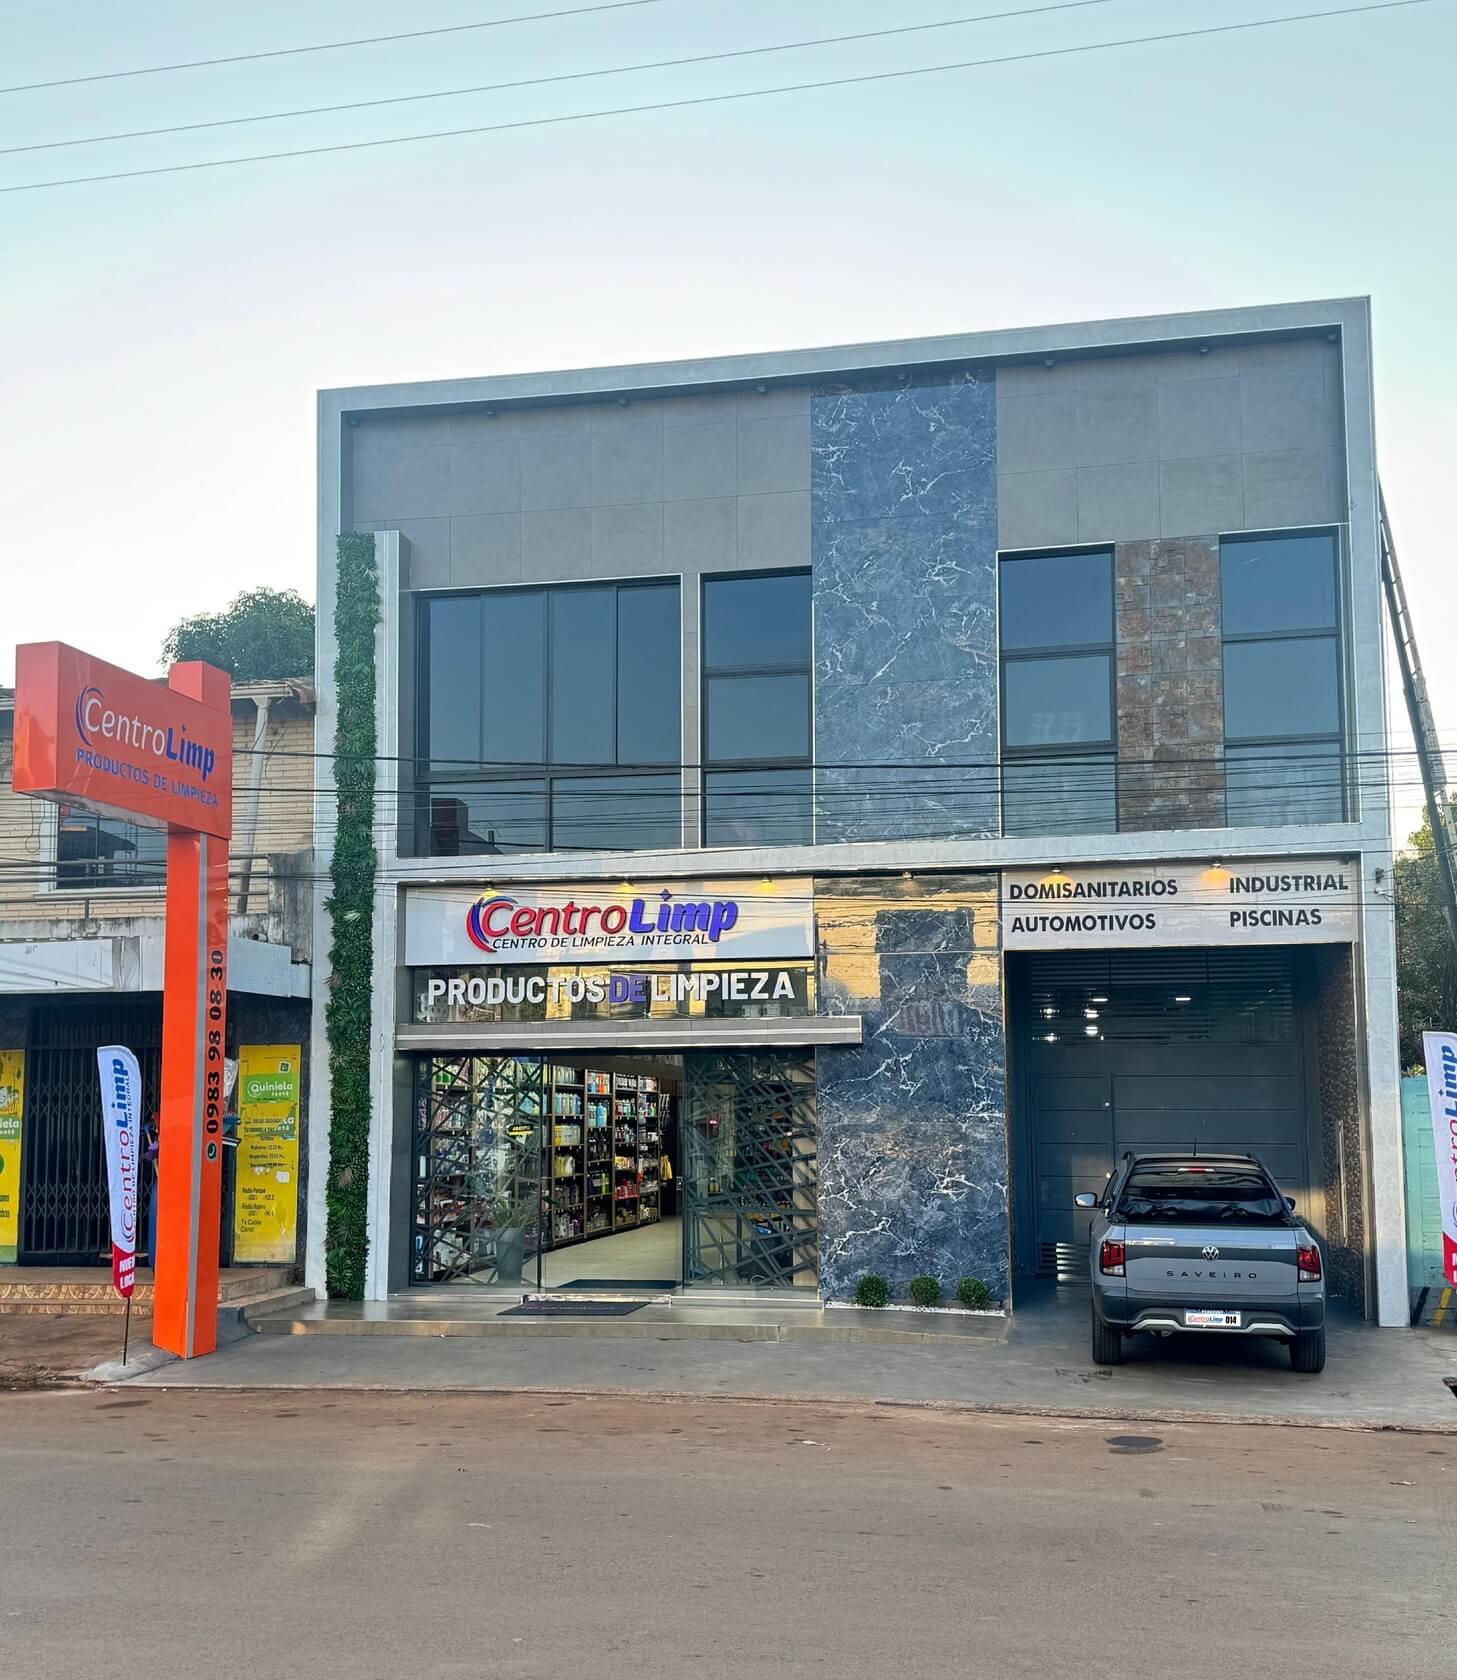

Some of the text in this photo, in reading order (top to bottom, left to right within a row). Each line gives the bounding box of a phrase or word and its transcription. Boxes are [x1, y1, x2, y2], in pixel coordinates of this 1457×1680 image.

[84, 697, 215, 781] CentroLimp
[76, 747, 219, 806] PRODUCTOS DE LIMPIEZA
[1010, 874, 1350, 899] DOMISANITARIOS INDUSTRIAL
[480, 889, 739, 942] CentroLimp
[1011, 908, 1323, 933] AUTOMOTIVOS PISCINAS
[492, 933, 709, 950] CENTRO DE LIMPIEZA INTEGRAL
[427, 971, 796, 1006] PRODUCTOS DE LIMPIEZA
[206, 950, 223, 1134] 0983 98 08 30
[112, 1058, 133, 1232] CentroLimp
[1166, 1270, 1257, 1279] SAVEIRO
[1225, 1315, 1237, 1324] 014
